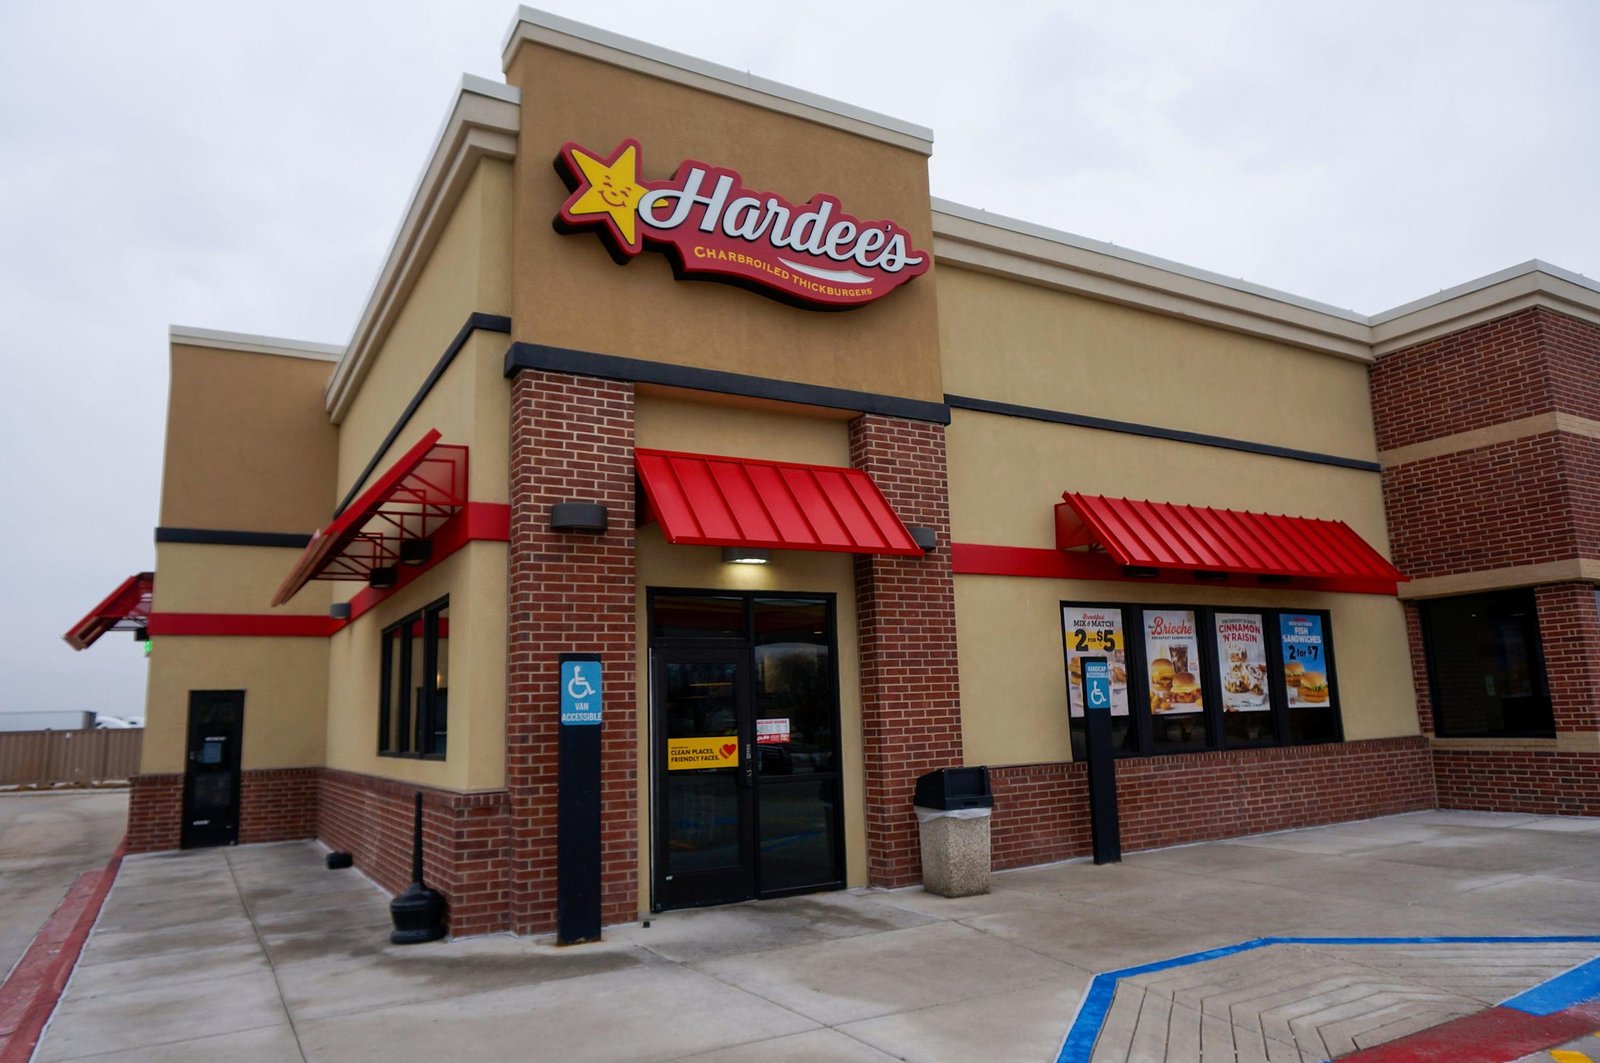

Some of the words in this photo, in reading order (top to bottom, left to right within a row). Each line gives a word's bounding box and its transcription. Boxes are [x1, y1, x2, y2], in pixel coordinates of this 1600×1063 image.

[638, 167, 923, 273] Hardee's
[693, 246, 790, 280] CHARBROILED
[791, 274, 872, 297] THICKBURGERS
[1151, 615, 1193, 636] Brioche
[1218, 623, 1261, 635] CINNAMON
[1074, 628, 1089, 652] 2
[1096, 629, 1116, 652] $5
[1231, 632, 1257, 643] RAISIN
[1281, 634, 1322, 644] SANDWICHES
[1288, 644, 1297, 660] 2
[1307, 645, 1319, 660] $7
[574, 702, 589, 711] VAN
[561, 712, 602, 722] ACCESSIBLE
[670, 755, 700, 763] FRIENDLY
